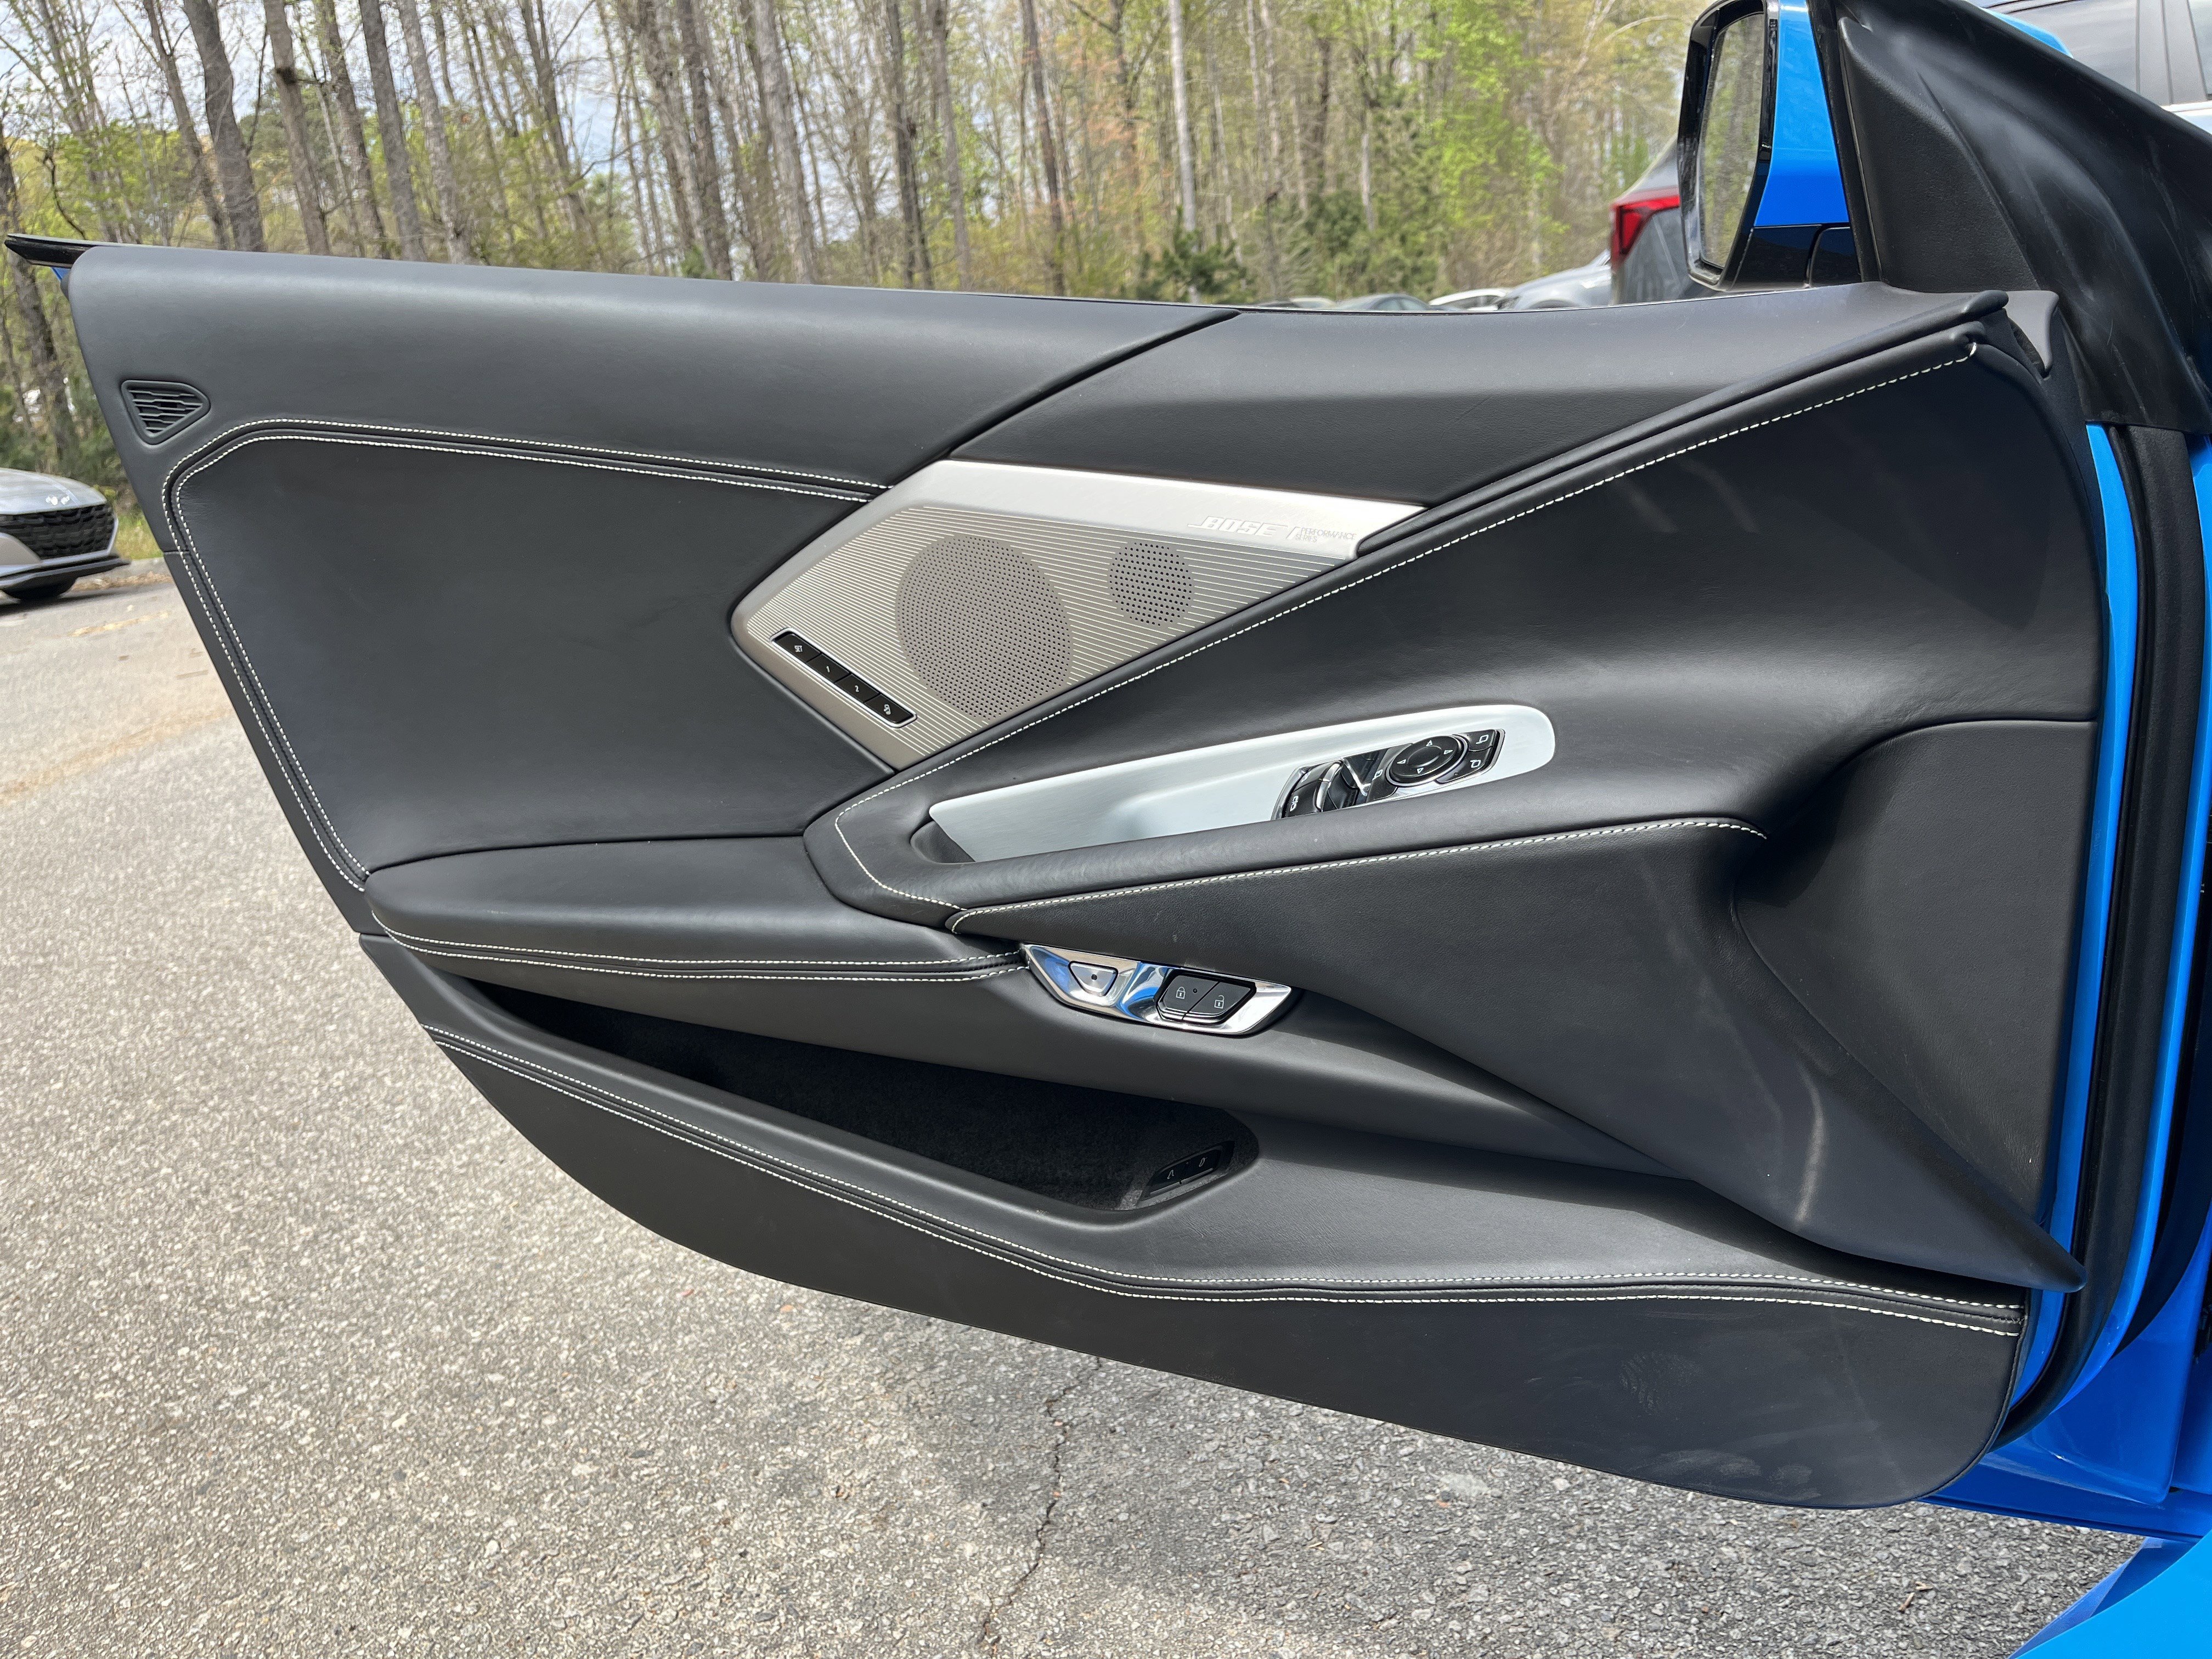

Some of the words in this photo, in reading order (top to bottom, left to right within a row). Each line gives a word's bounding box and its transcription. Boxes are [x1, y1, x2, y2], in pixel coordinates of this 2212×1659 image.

[1187, 516, 1288, 537] BOSE
[1300, 527, 1357, 540] PERFORMANCE
[1295, 533, 1317, 543] SERIES
